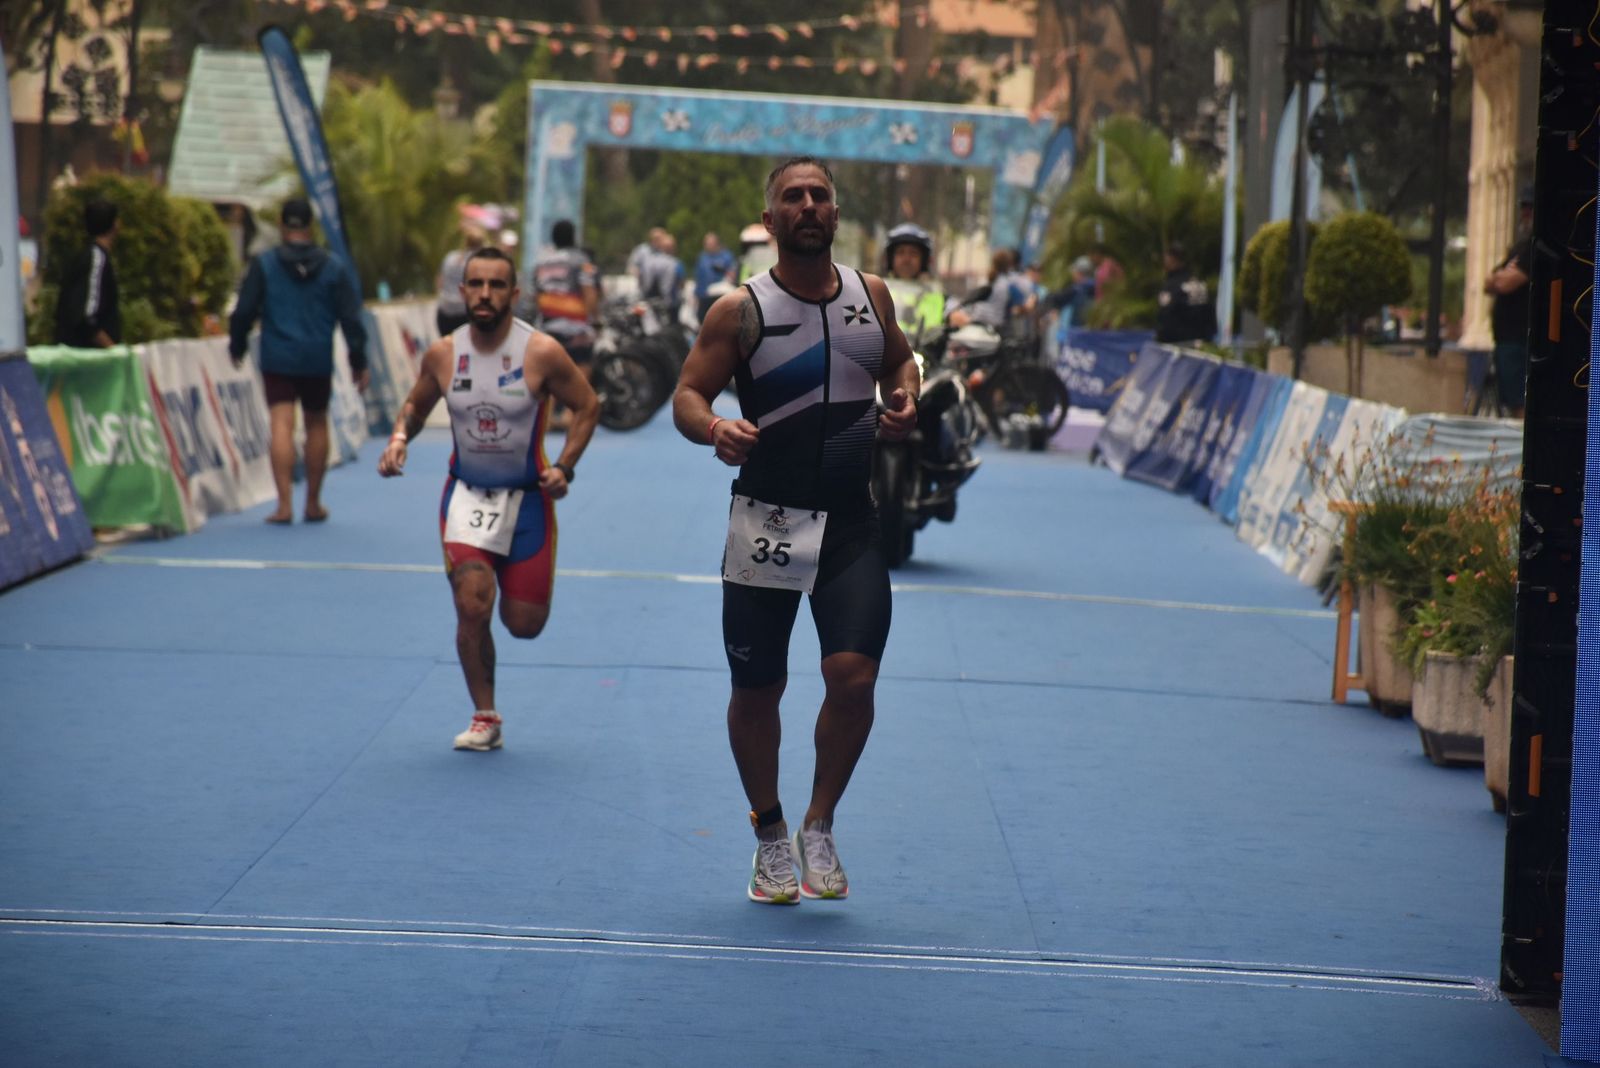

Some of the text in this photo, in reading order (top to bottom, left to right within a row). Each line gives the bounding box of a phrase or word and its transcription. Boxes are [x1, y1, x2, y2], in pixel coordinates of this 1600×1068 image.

[468, 509, 500, 531] 37
[763, 522, 790, 535] FETRICE
[751, 537, 792, 567] 35
